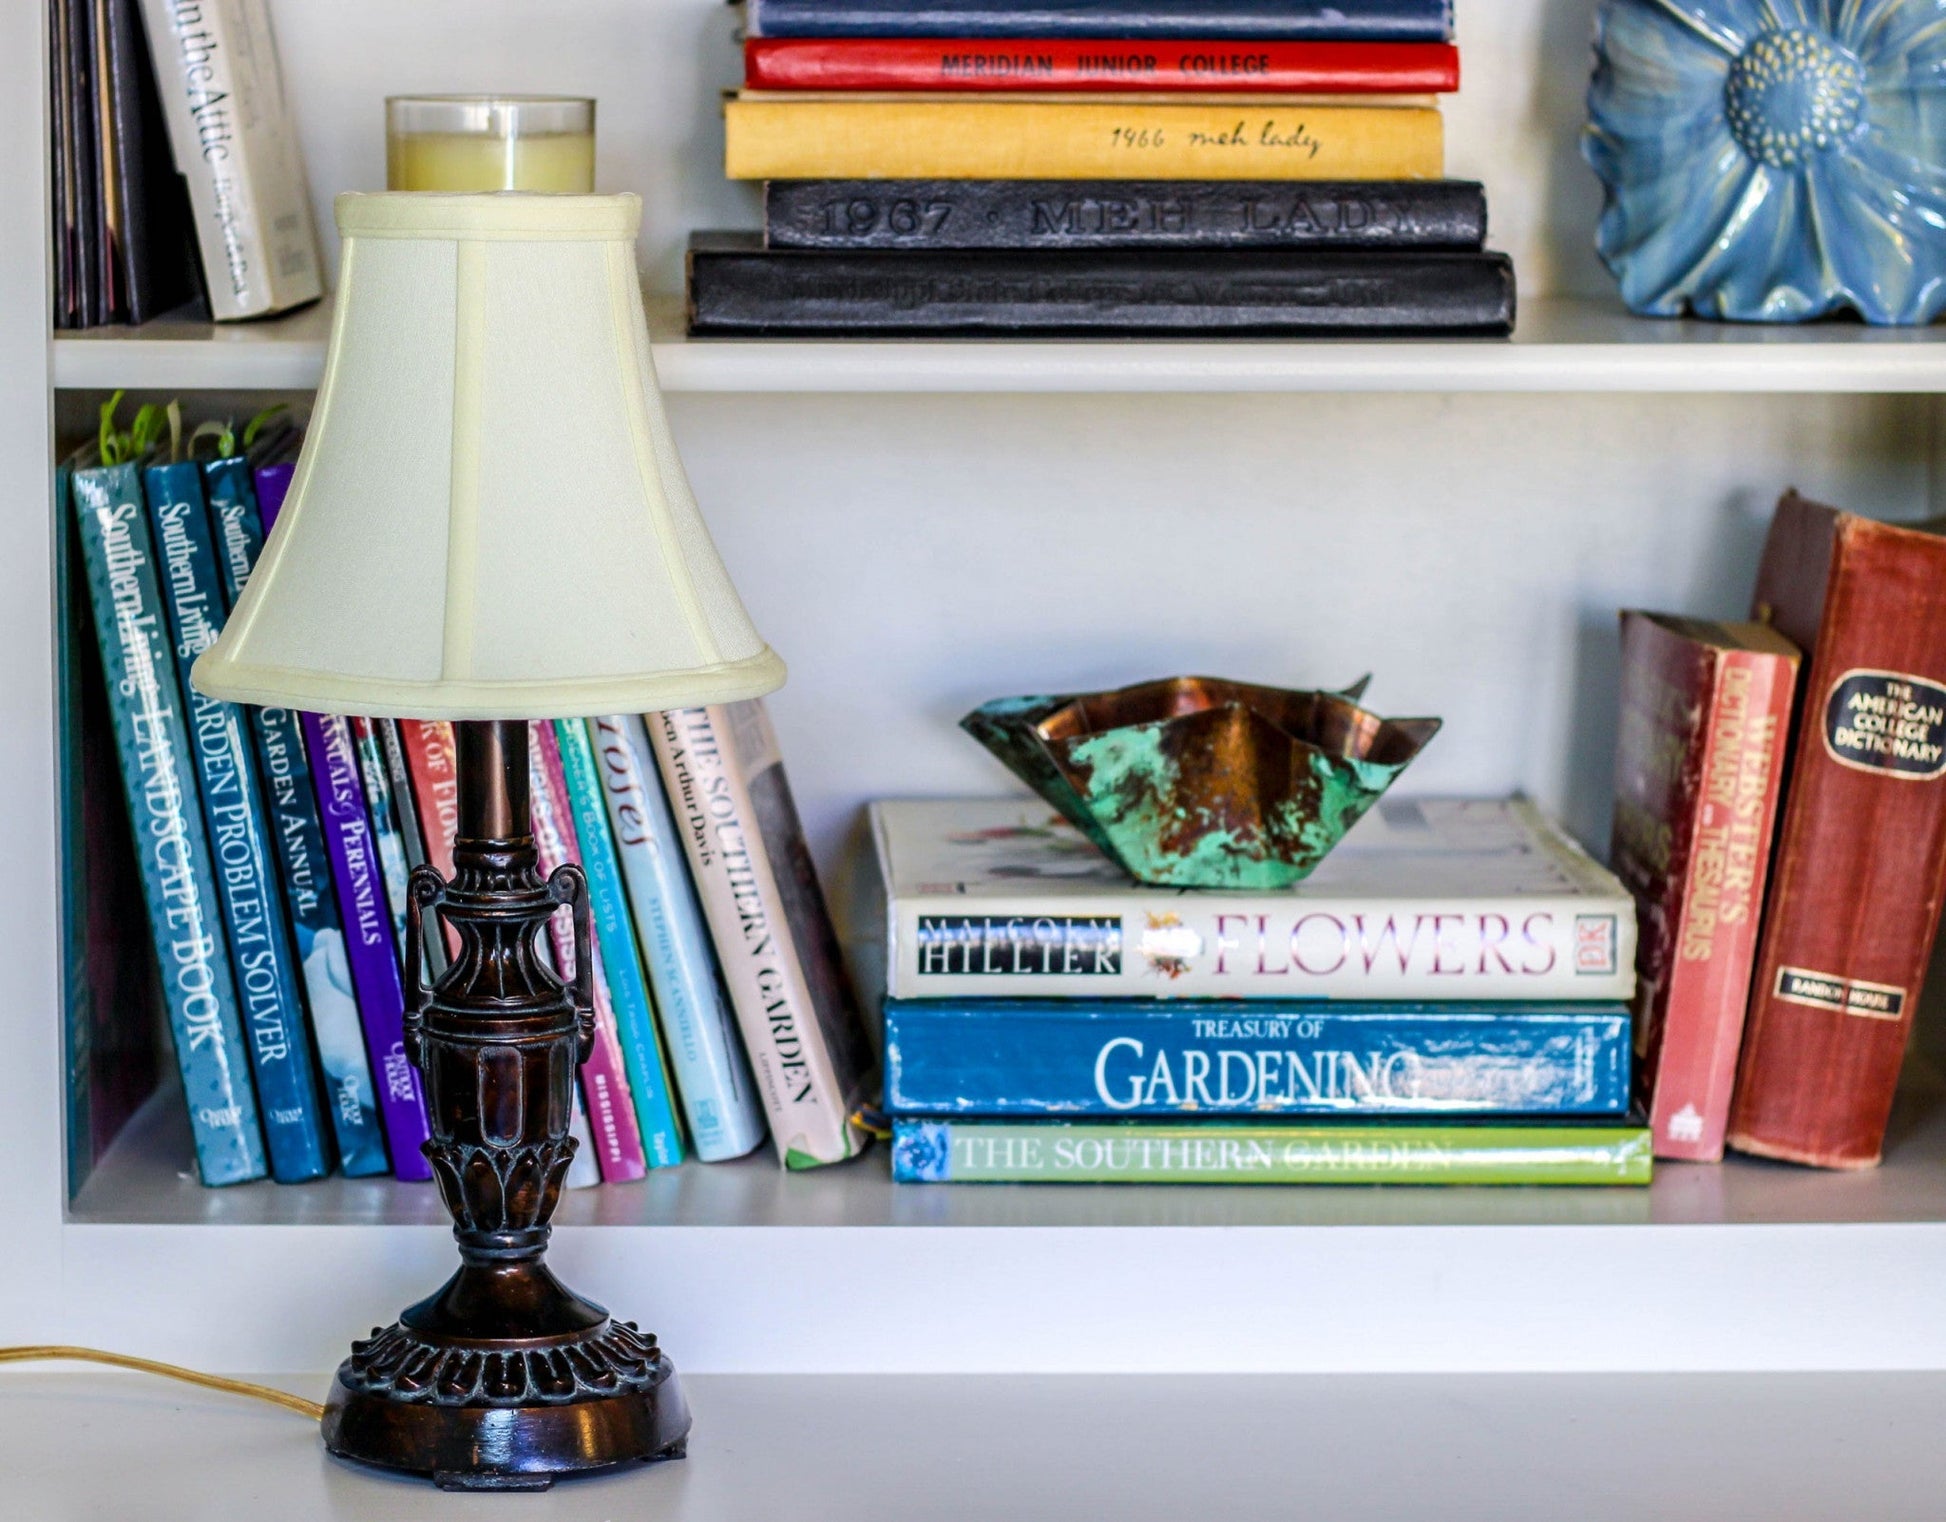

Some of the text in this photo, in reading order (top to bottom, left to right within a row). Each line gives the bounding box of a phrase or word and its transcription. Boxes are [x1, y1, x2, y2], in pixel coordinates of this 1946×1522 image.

[181, 32, 217, 81] the
[940, 54, 1270, 77] MERIDIAN JUNIOR COLLEGE
[187, 86, 232, 163] Attic
[1188, 122, 1248, 148] meh
[1258, 120, 1324, 159] lady
[820, 199, 953, 237] 1967
[1031, 199, 1193, 236] MEH
[158, 501, 198, 597] Southern
[220, 504, 251, 580] Southern
[1847, 692, 1944, 727] AMERICAN
[1885, 682, 1913, 701] THE
[1834, 726, 1943, 764] DICTIONARY
[1852, 711, 1930, 744] COLLEGE
[105, 502, 146, 617] Southern
[172, 933, 226, 1051] BOOK
[583, 811, 601, 856] BOOK
[671, 746, 698, 812] Arthur
[689, 813, 712, 866] Davis
[1684, 667, 1752, 962] DICTIONARY THESAURUS
[1720, 715, 1778, 925] WEBSTER'S
[281, 813, 318, 916] ANNUAL
[340, 820, 382, 945] PERENNIALS
[593, 861, 607, 883] OF
[213, 801, 267, 945] PROBLEM
[240, 948, 288, 1065] SOLVER
[599, 889, 617, 934] LISTS
[707, 773, 775, 957] SOUTHERN
[757, 967, 817, 1105] GARDEN
[923, 942, 1117, 974] HILLIER
[1212, 912, 1556, 977] FLOWERS
[1577, 922, 1608, 968] DK
[648, 897, 698, 1061] STEPHEN SCANNIELLO
[1192, 1019, 1325, 1039] TREASURY OF
[1094, 1036, 1420, 1110] GARDENING
[594, 1073, 621, 1162] MISSISSIPPI
[956, 1137, 1044, 1170] THE
[1054, 1137, 1275, 1170] SOUTHERN
